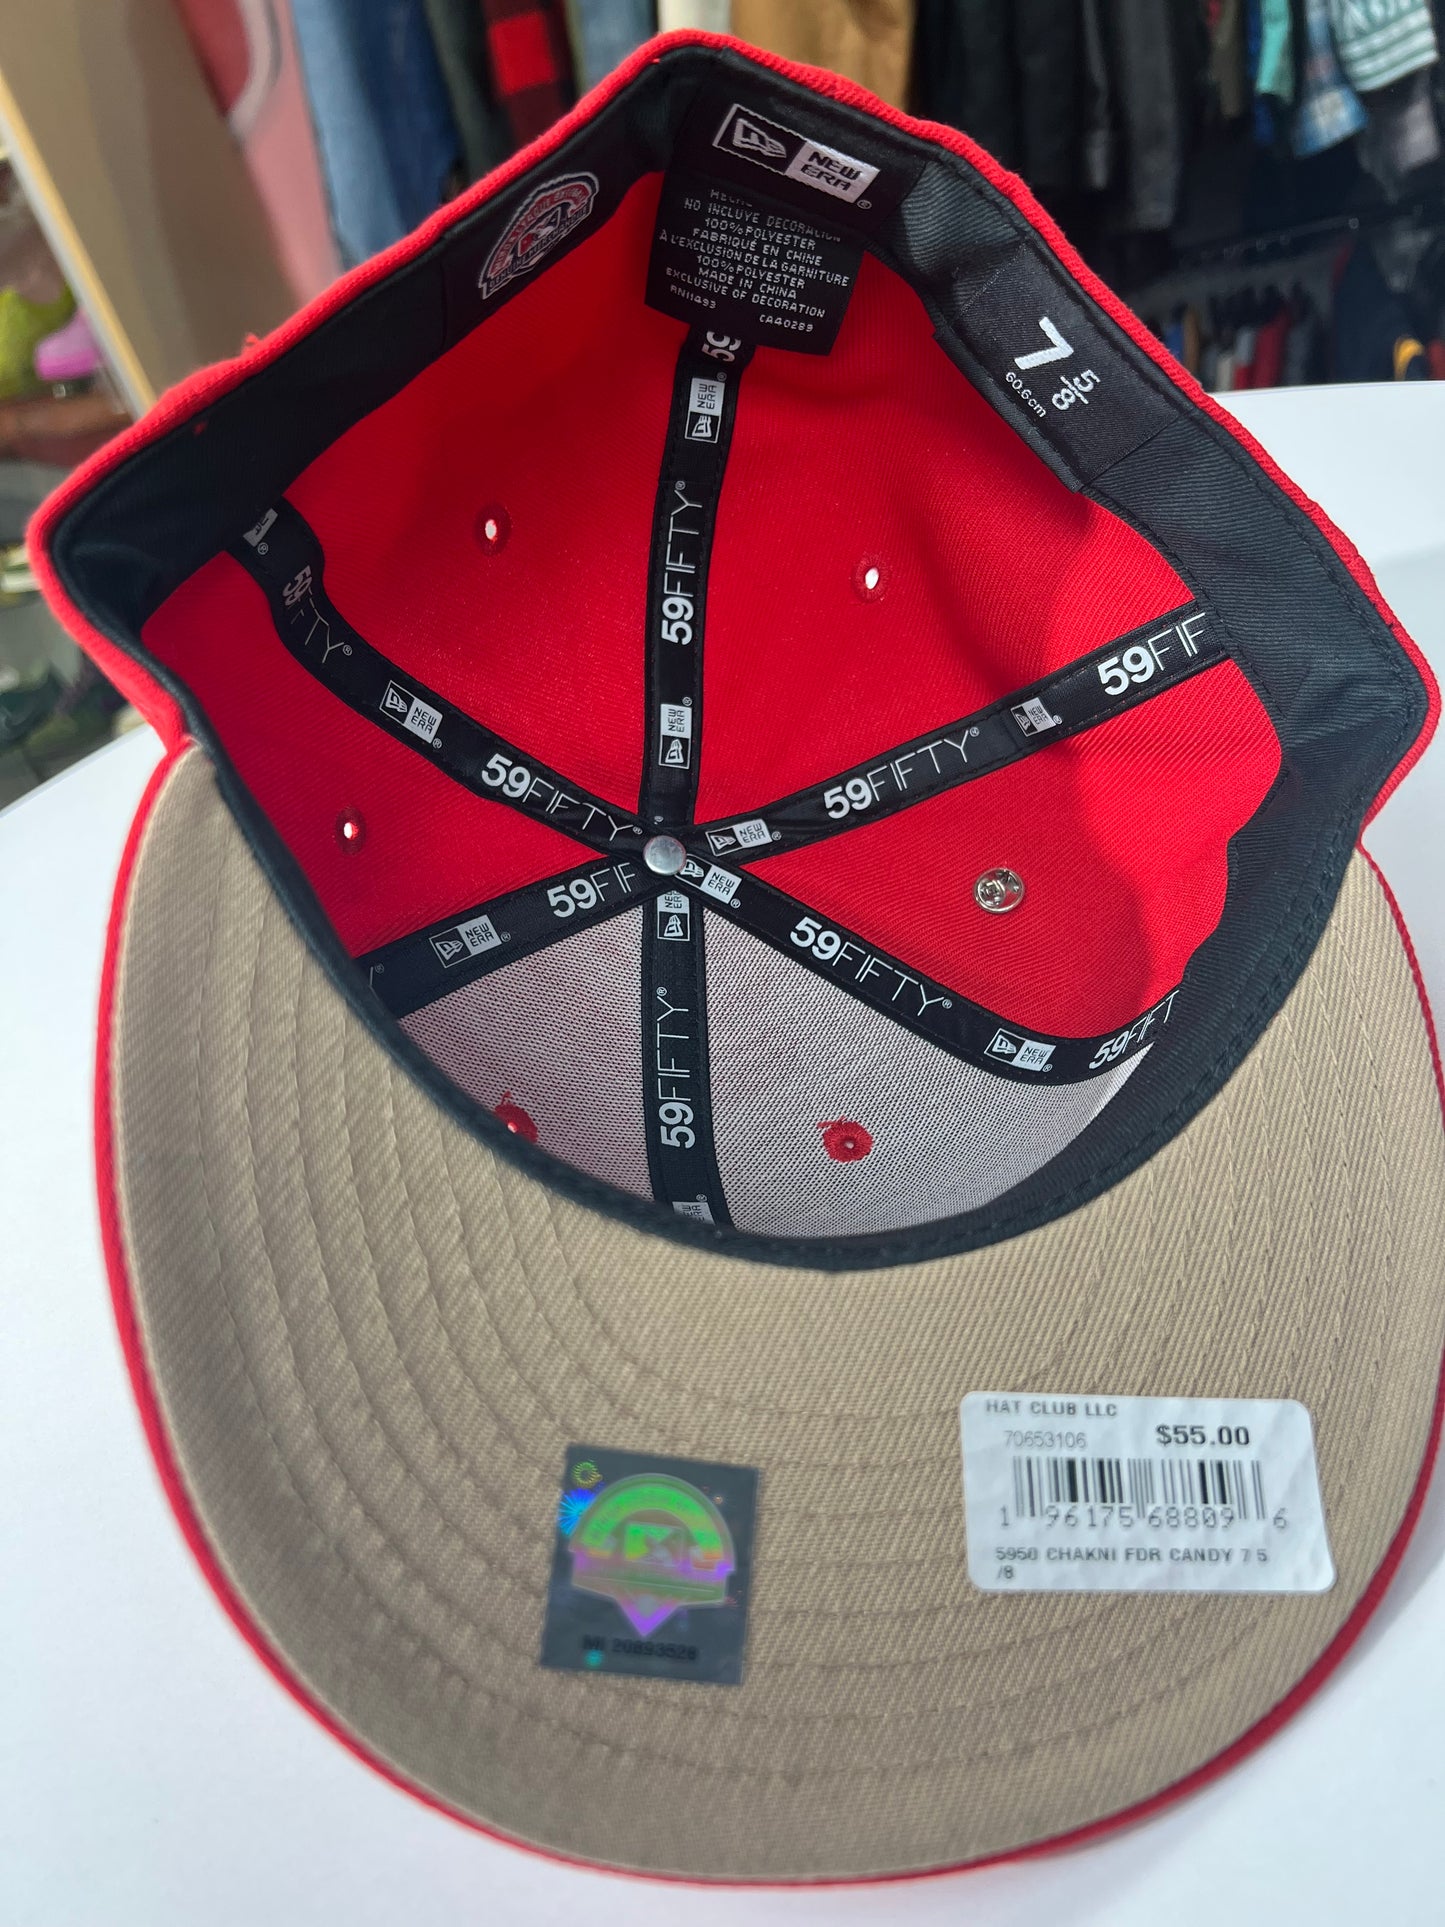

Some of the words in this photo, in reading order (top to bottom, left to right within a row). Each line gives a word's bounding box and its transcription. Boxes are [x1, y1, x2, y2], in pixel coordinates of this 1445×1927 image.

[809, 151, 862, 180] NEW
[800, 164, 852, 191] ERA
[683, 198, 701, 211] NO
[707, 203, 761, 223] INCLUYE
[693, 228, 757, 251] FABRIQUÉ
[762, 244, 780, 257] EN
[786, 249, 823, 267] CHINE
[744, 253, 760, 265] DE
[762, 257, 778, 269] LA
[781, 262, 850, 287] GARNITURE
[666, 267, 728, 295] EXCLUSIVE
[732, 289, 747, 300] OF
[751, 293, 826, 318] DECORATION
[698, 267, 735, 285] MADE
[739, 278, 753, 289] IN
[759, 283, 797, 299] CHINA
[1014, 316, 1074, 370] 7
[696, 383, 708, 409] NEW
[706, 385, 717, 410] ERA
[410, 715, 434, 735] ERA
[413, 706, 437, 727] NEW
[668, 708, 677, 732] NEW
[676, 710, 685, 733] ERA
[739, 823, 762, 837] NEW
[743, 831, 766, 844] ERA
[708, 880, 731, 895] ERA
[713, 872, 735, 888] NEW
[465, 922, 490, 939] NEW
[470, 931, 494, 947] ERA
[1020, 1054, 1044, 1064] ERA
[1024, 1047, 1048, 1058] NEW
[986, 1400, 1021, 1414] HAT
[1030, 1401, 1077, 1416] CLUB
[1085, 1403, 1118, 1417] LLC
[1004, 1430, 1087, 1448] 70653106
[1156, 1424, 1250, 1446] $55.00
[1001, 1505, 1009, 1526] 1
[1273, 1507, 1288, 1529] 6
[996, 1547, 1038, 1561] 5950
[1046, 1547, 1116, 1561] CHAKNI
[1125, 1547, 1162, 1561] FDR
[1169, 1548, 1232, 1562] CANDY
